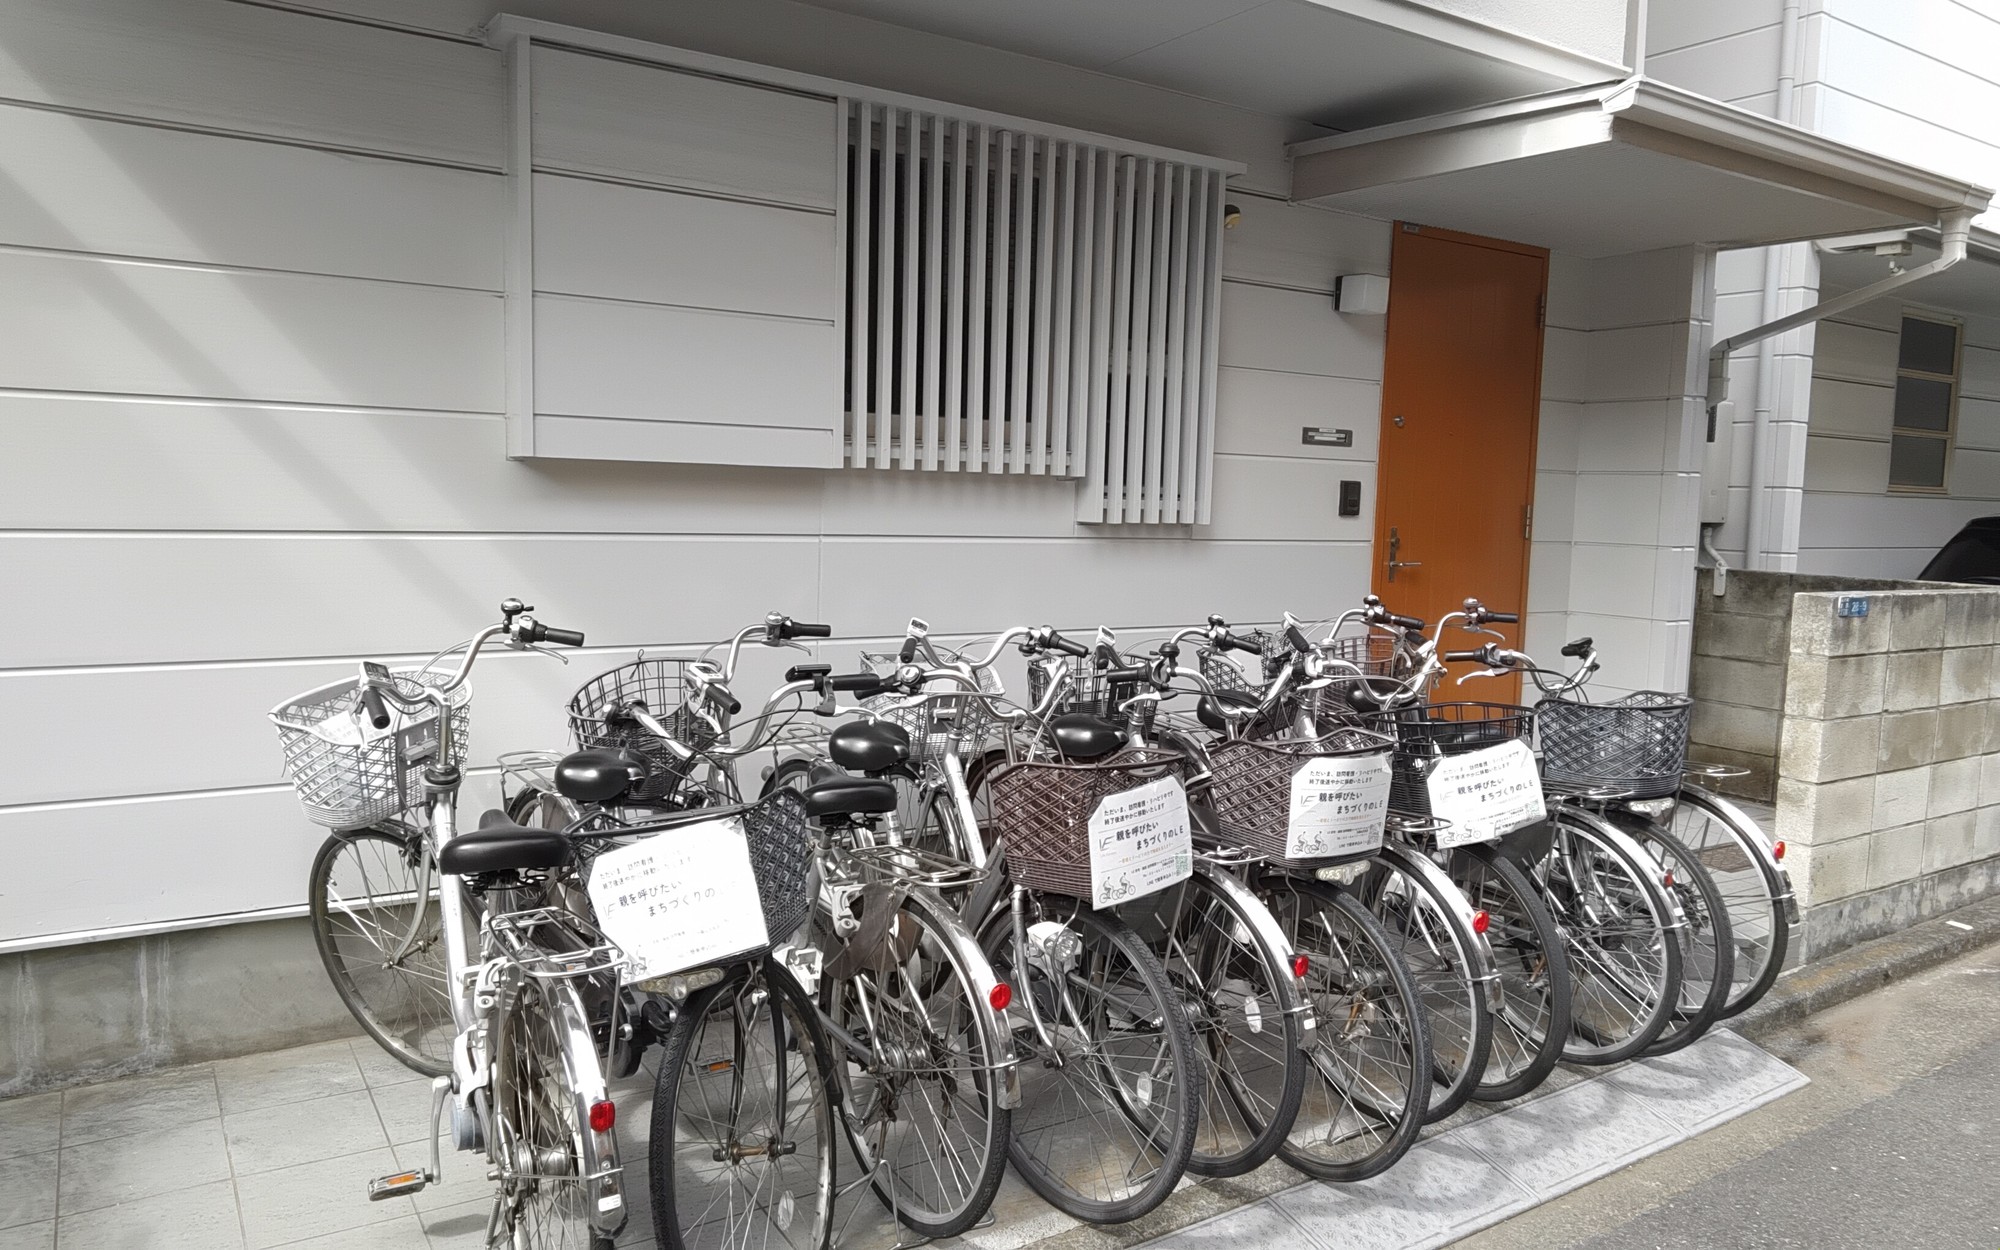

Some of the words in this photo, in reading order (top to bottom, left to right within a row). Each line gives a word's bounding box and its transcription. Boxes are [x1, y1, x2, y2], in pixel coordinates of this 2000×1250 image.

[1116, 822, 1159, 841] 親を呼びたい
[618, 881, 682, 907] 親を呼びたい
